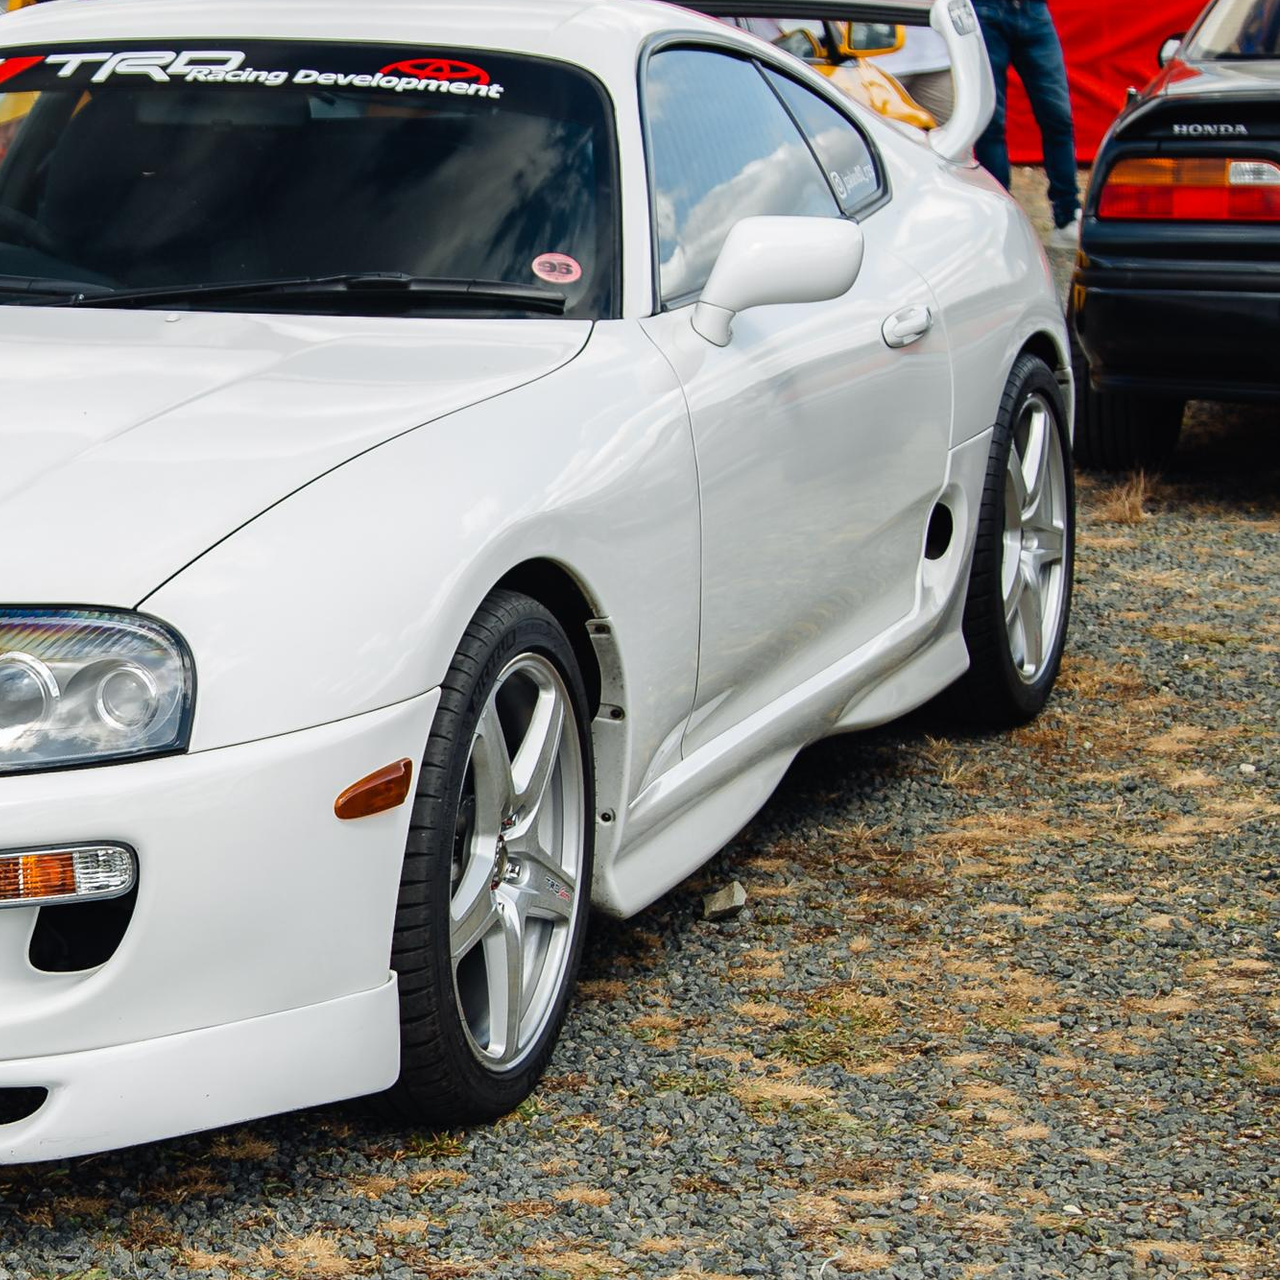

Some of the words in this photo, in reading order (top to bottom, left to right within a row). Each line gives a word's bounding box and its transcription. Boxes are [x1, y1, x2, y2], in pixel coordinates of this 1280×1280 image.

[45, 50, 246, 83] TRD
[185, 67, 288, 86] Racing
[292, 69, 504, 99] Development
[1172, 124, 1248, 135] HONDA
